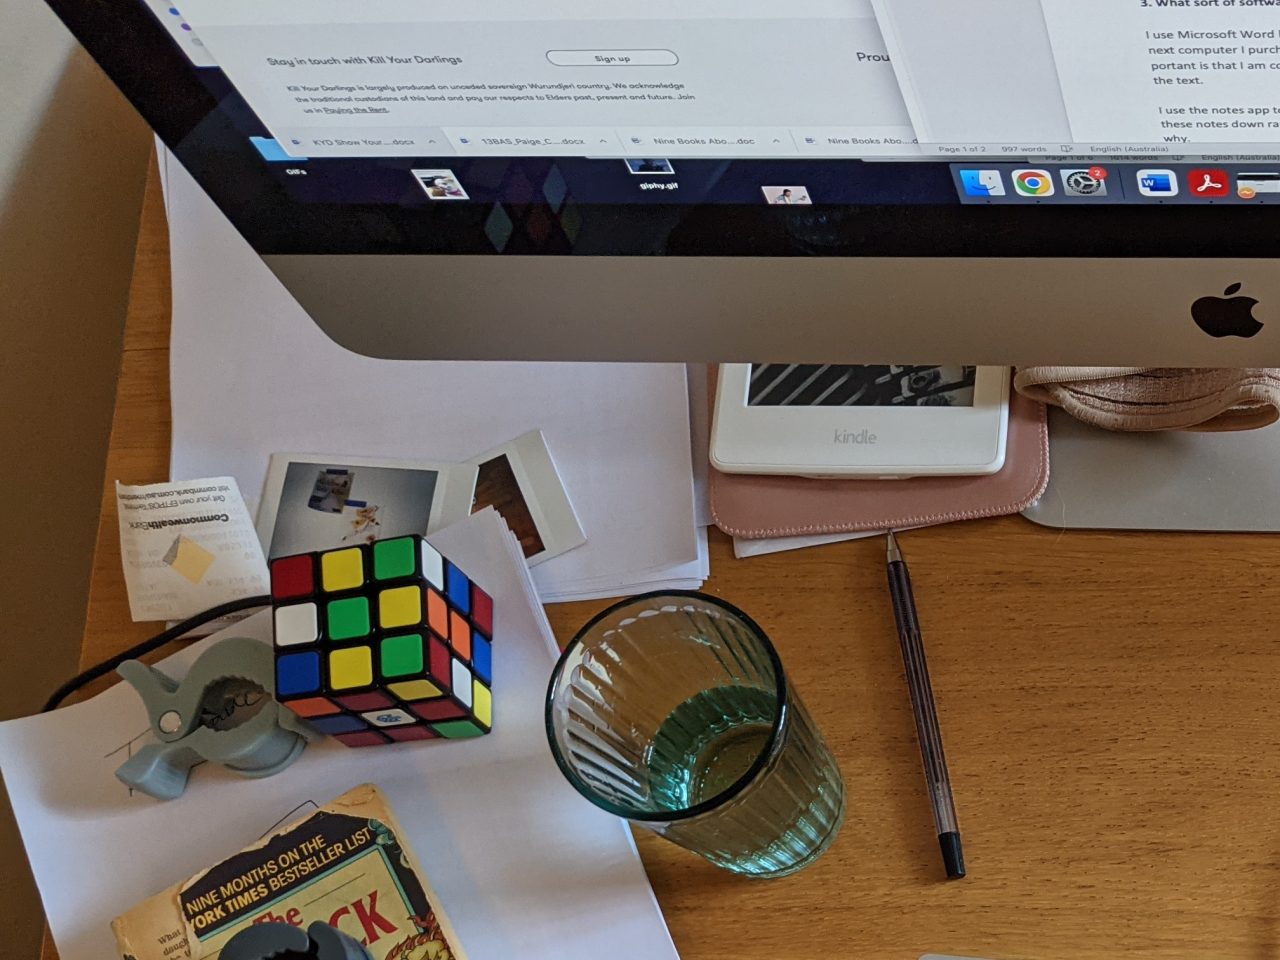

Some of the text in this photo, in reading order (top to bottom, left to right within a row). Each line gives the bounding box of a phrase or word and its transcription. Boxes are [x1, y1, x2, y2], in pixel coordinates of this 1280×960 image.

[1177, 29, 1237, 39] Microsoft
[1239, 29, 1274, 38] Word
[1148, 46, 1175, 54] next
[1178, 46, 1237, 56] computer
[266, 57, 296, 67] Stay
[307, 56, 341, 65] touch
[342, 56, 367, 64] with
[367, 55, 386, 64] Kill
[386, 55, 412, 64] Your
[413, 55, 463, 65] Darlings
[594, 55, 616, 64] Sign
[1151, 62, 1196, 71] portant
[1199, 61, 1209, 69] is
[1211, 60, 1237, 69] that
[1153, 76, 1173, 84] the
[653, 137, 675, 145] Nine
[677, 137, 706, 145] Books
[1020, 145, 1047, 153] words
[1090, 145, 1169, 154] English (Australia)
[640, 182, 678, 191] giphy.gif
[833, 429, 877, 445] kindle
[186, 834, 327, 915] NINE MONTHS ON THE
[225, 883, 269, 913] TIMES
[269, 843, 346, 891] BESTSELLER
[345, 827, 372, 851] LIST
